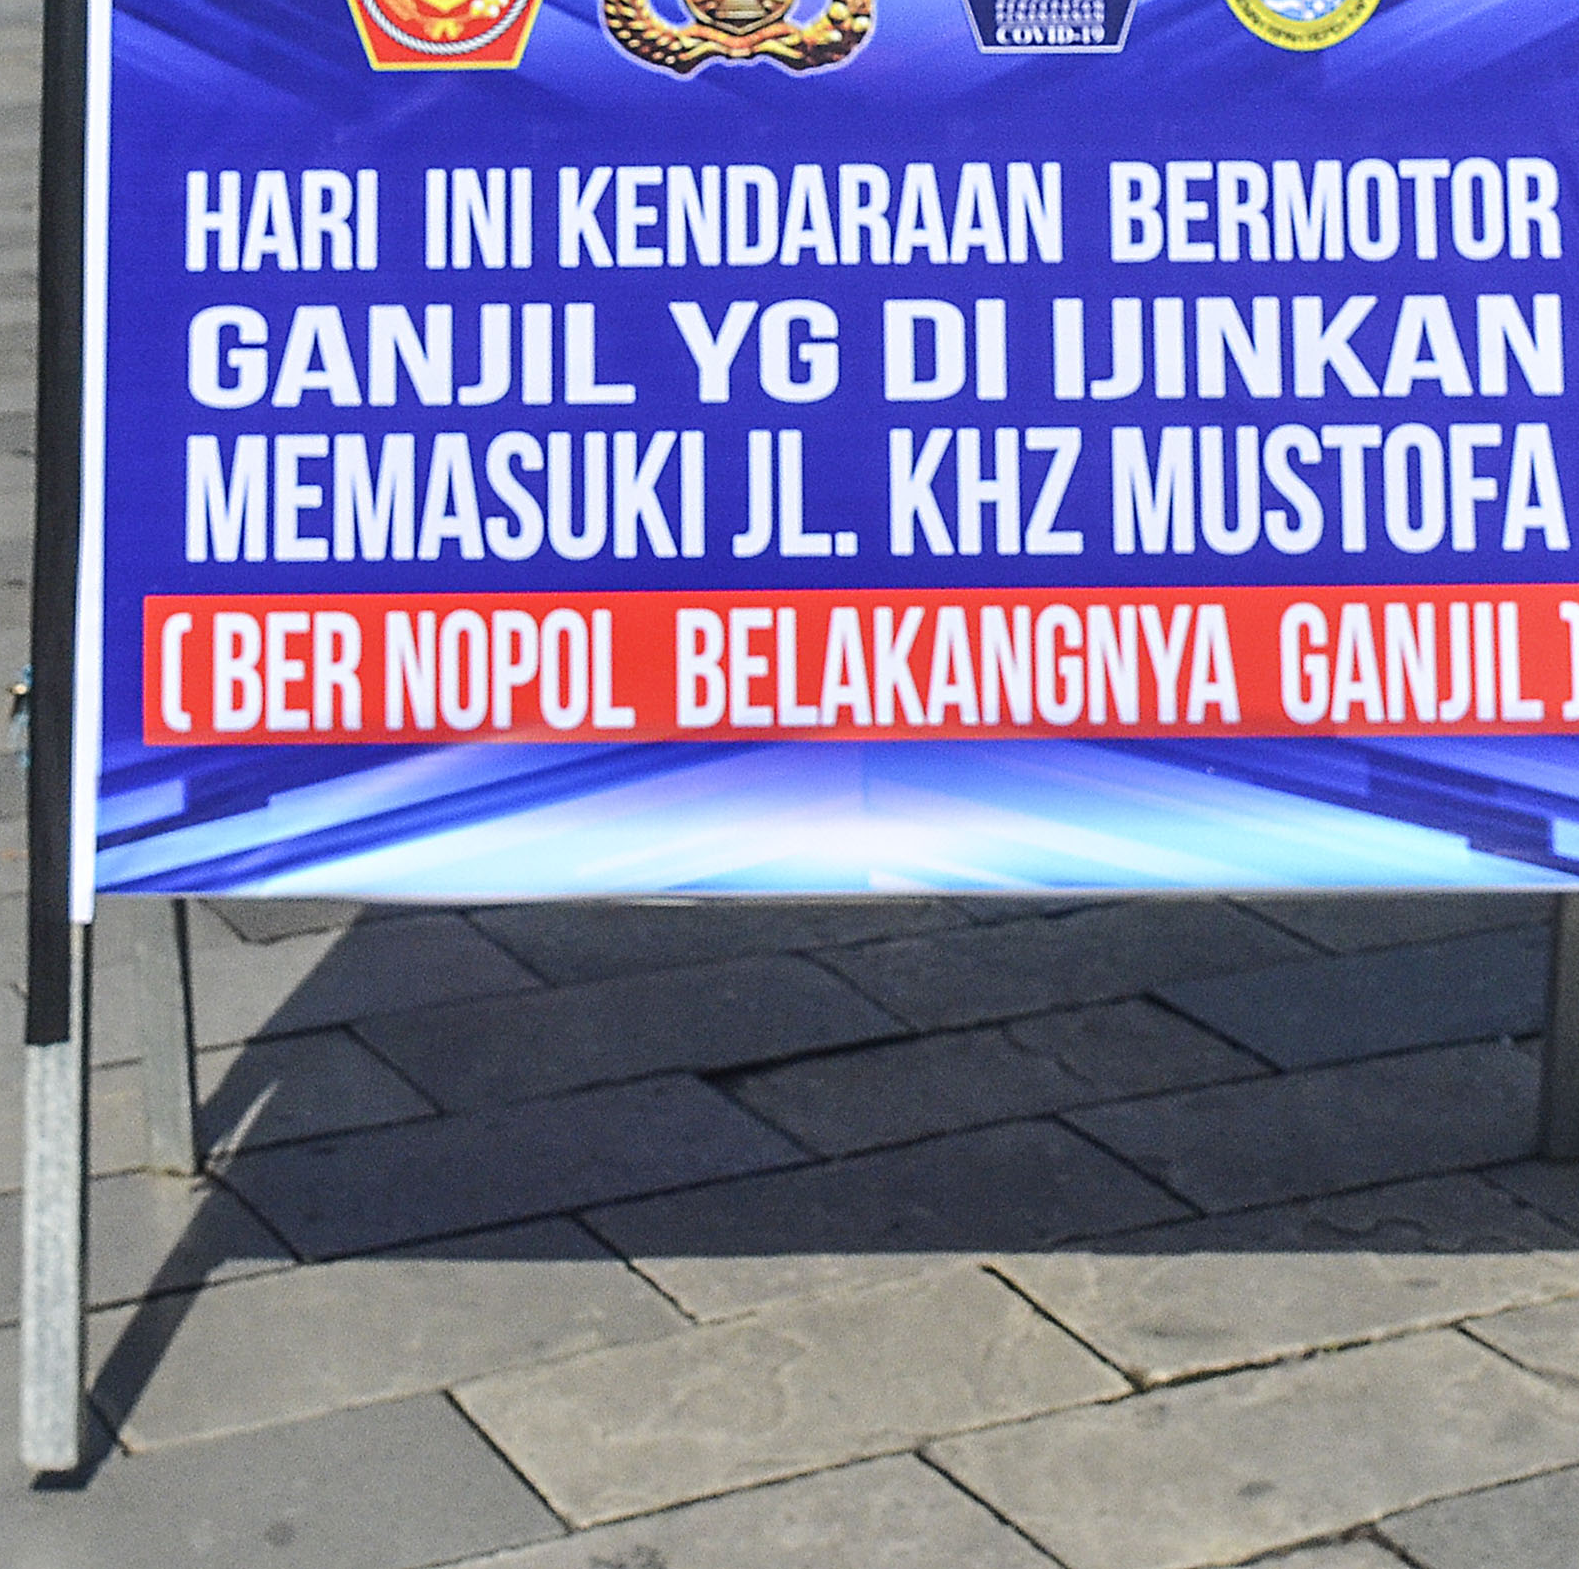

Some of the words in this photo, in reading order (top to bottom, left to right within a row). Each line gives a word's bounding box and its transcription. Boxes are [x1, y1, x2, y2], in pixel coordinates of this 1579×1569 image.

[996, 25, 1105, 45] COVID-19
[185, 169, 378, 272] HARI
[425, 167, 532, 269] INI
[558, 162, 1063, 268] KENDARAAN
[1109, 157, 1562, 263] BERMOTOR
[188, 302, 636, 409] GANJIL
[668, 299, 839, 403] YG
[883, 298, 1007, 401] DI
[1052, 293, 1565, 400] IJINKAN
[186, 430, 705, 563] MEMASUKI
[733, 429, 858, 558] JL.
[889, 427, 1084, 556] KHZ
[1111, 423, 1571, 555] MUSTOFA
[385, 608, 636, 730] NOPOL
[676, 604, 1241, 728] BELAKANGNYA
